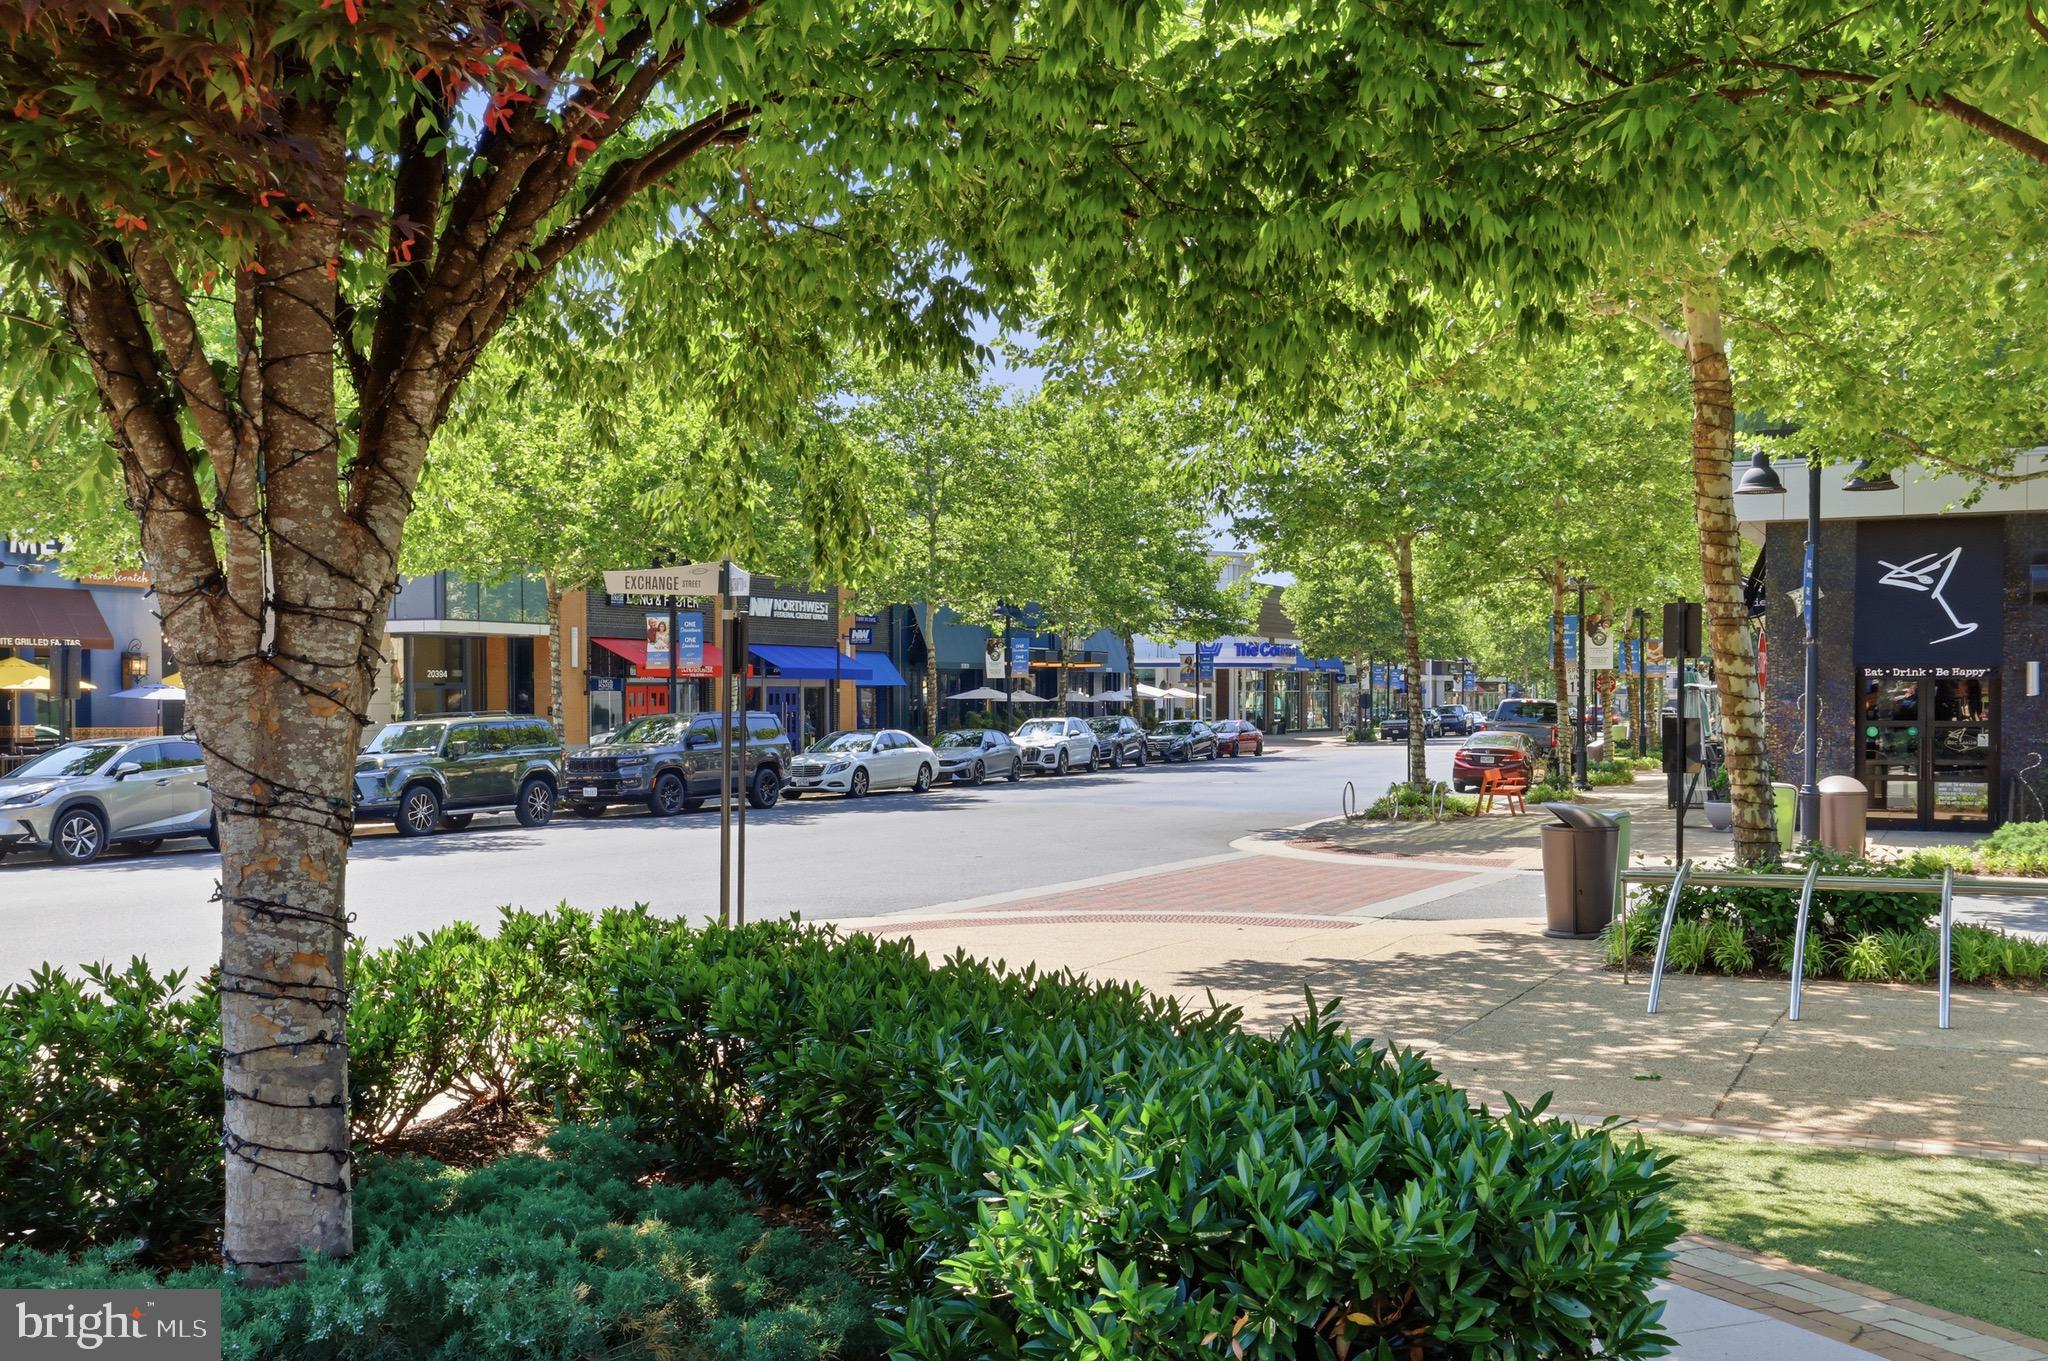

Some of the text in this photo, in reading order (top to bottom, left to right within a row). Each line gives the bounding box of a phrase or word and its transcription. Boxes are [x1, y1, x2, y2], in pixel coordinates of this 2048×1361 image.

[625, 575, 702, 590] EXCHANGE STREET
[773, 598, 829, 614] NORTHWEST
[14, 638, 49, 646] GRILLED
[50, 638, 81, 646] FAITAS
[1864, 668, 1884, 677] Eat
[1893, 668, 1927, 677] Drink
[1936, 668, 1950, 677] Be
